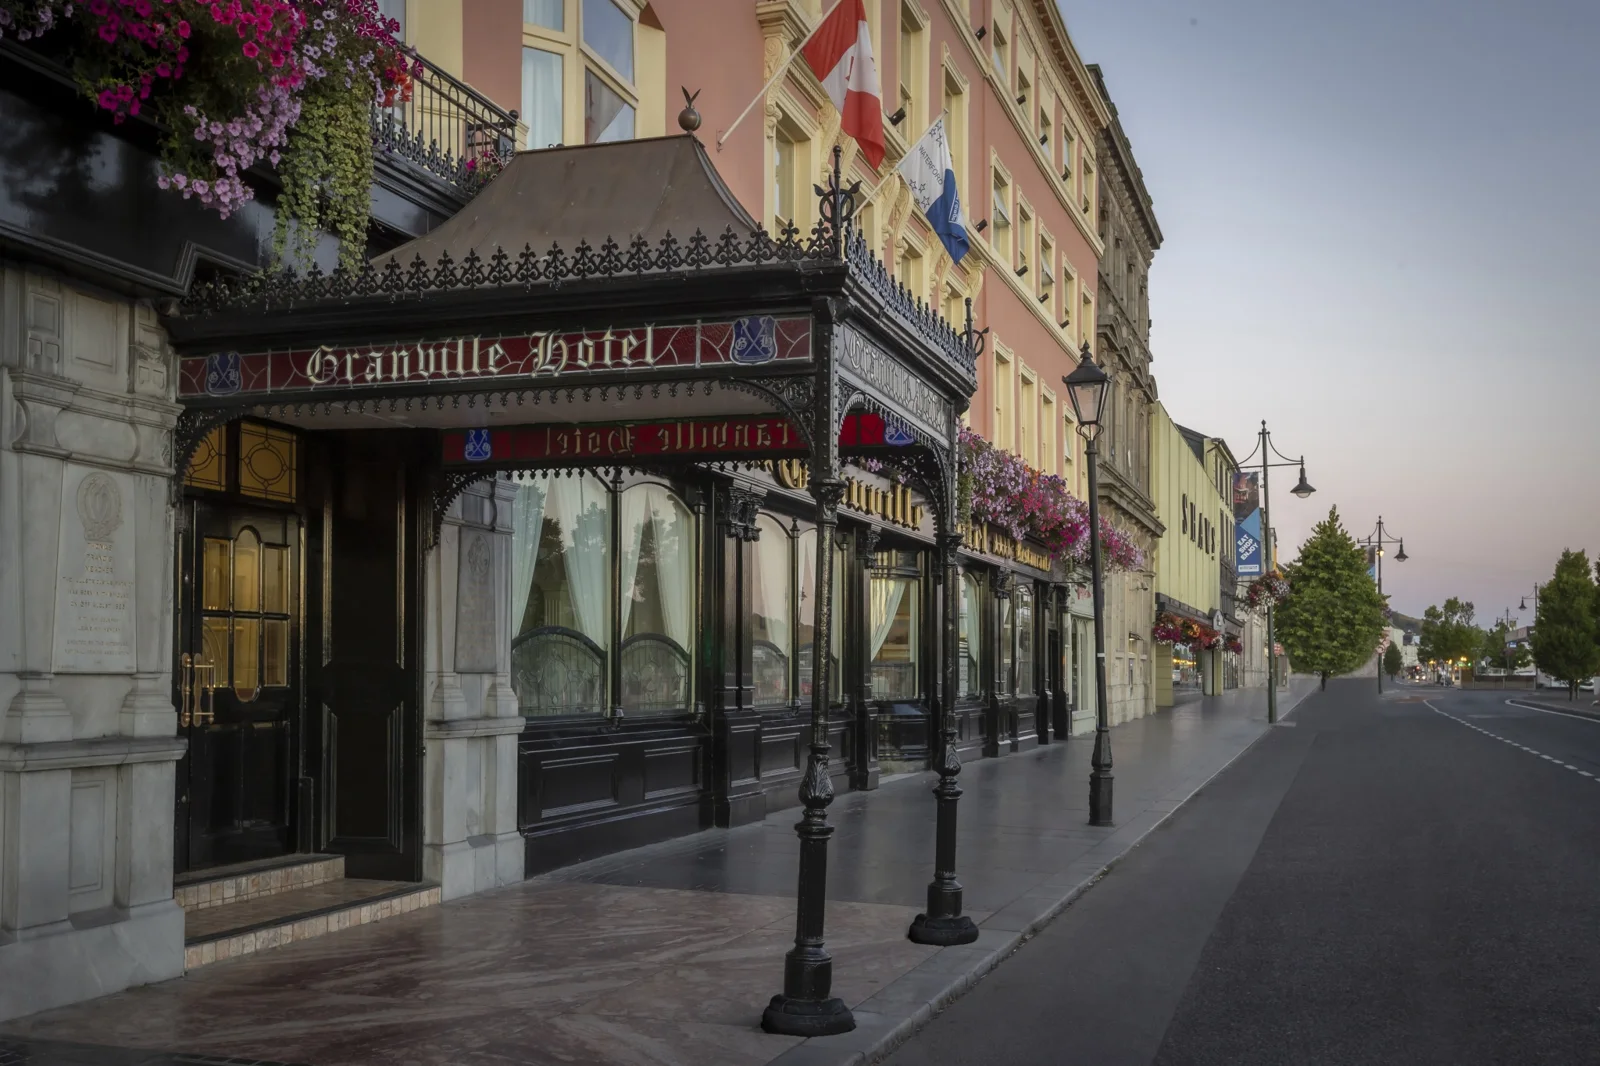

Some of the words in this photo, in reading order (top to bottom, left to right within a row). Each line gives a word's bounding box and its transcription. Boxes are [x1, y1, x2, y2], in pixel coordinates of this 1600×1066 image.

[919, 145, 943, 186] WATERFORD
[306, 336, 504, 385] Granville
[530, 325, 655, 377] Hotel
[1237, 533, 1249, 546] EAT
[1238, 538, 1253, 553] SHOP
[1240, 542, 1259, 560] ENJOY
